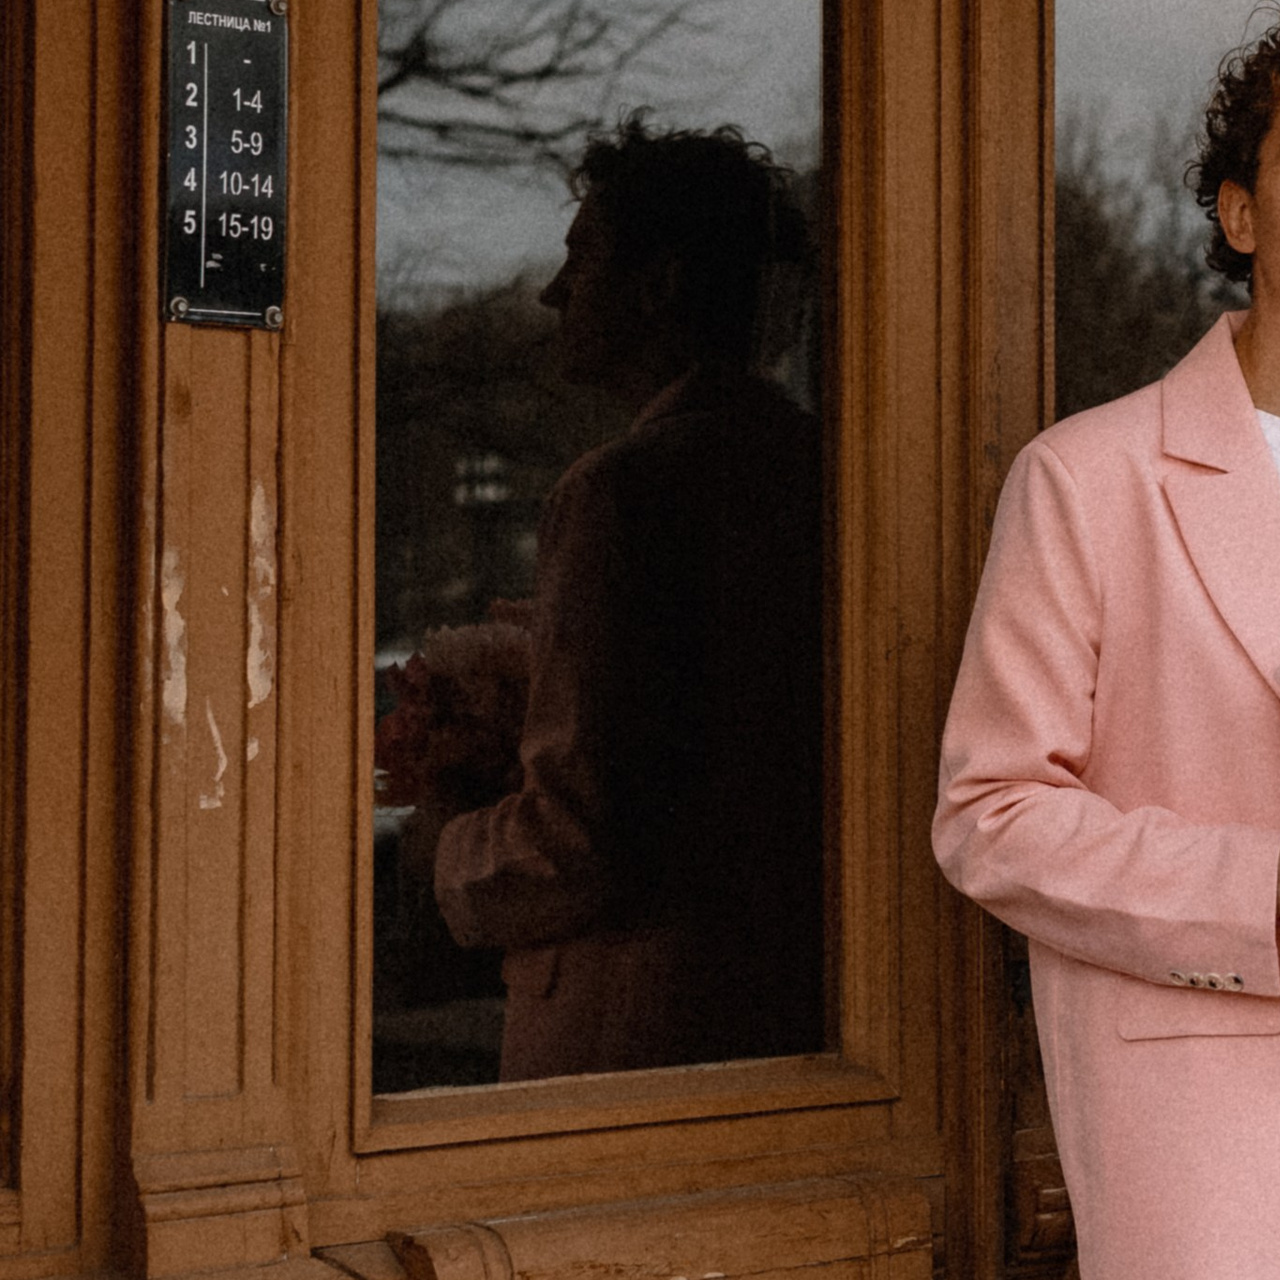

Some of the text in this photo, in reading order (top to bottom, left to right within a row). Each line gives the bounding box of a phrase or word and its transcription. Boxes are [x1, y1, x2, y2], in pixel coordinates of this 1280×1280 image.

[188, 11, 252, 32] ЛЕСТНИЦА
[186, 40, 196, 65] 1
[185, 82, 263, 114] 2 1-4
[185, 125, 263, 156] 3 5-9
[183, 167, 274, 198] 4 10-14
[183, 210, 274, 241] 5 15-19
